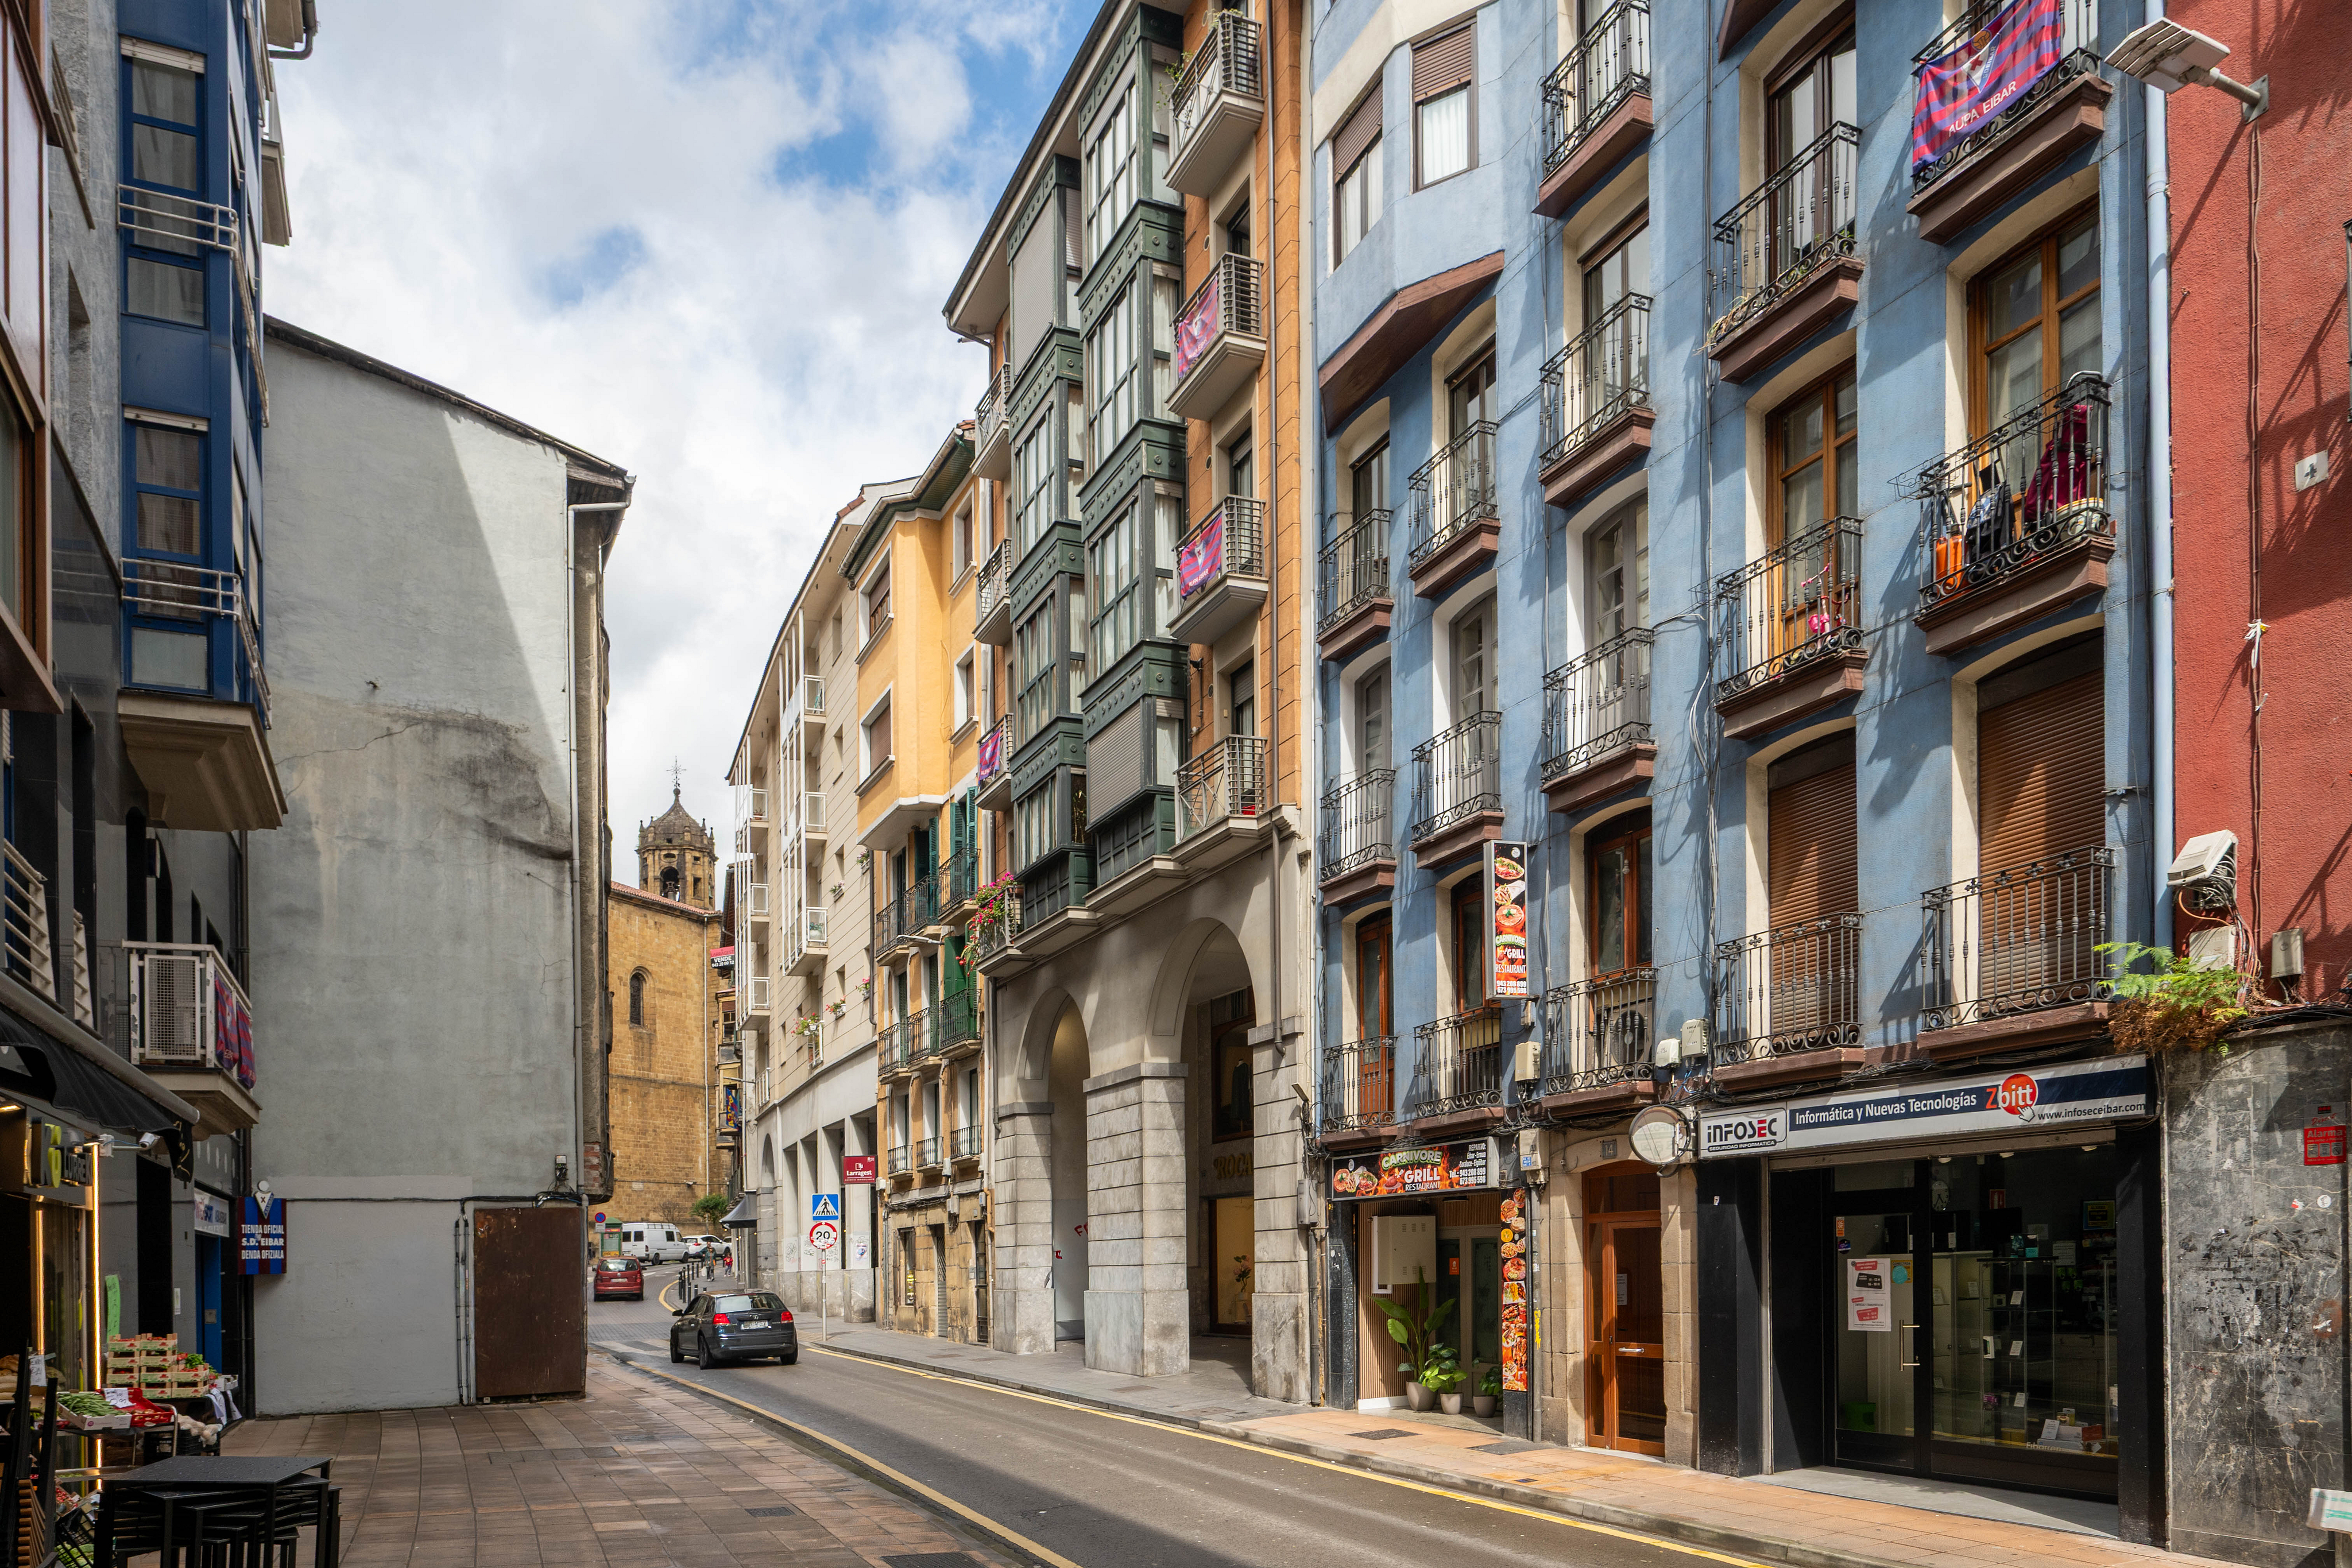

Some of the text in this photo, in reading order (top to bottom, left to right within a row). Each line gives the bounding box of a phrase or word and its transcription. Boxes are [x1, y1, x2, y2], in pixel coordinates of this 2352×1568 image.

[1949, 81, 2017, 137] AUPA EIBAR
[1496, 934, 1526, 946] CARNIVORE
[1507, 948, 1526, 959] GRILL
[1495, 964, 1526, 973] RESTAURANT
[1986, 1084, 2033, 1109] Zbitt
[1796, 1092, 1977, 1125] Informática y Nuevas Tecnologías
[2038, 1102, 2146, 1120] www.infoseceibar.com
[2307, 1129, 2343, 1138] Alarma
[1469, 1143, 1486, 1151] REPARTO:
[1605, 1144, 1614, 1155] 14
[1382, 1150, 1442, 1170] CARNIVORE
[1404, 1167, 1440, 1183] GRILL
[1459, 1169, 1468, 1177] 943
[1468, 1168, 1476, 1176] 208
[1477, 1167, 1486, 1175] 899
[1460, 1175, 1486, 1185] 673 995 598
[1405, 1181, 1441, 1191] RESTAURANT
[241, 1225, 284, 1234] TIENDA OFICIAL
[816, 1231, 830, 1240] 20
[241, 1238, 284, 1246] S.D. EIBAR
[241, 1250, 284, 1260] DENDA OFIZIALA
